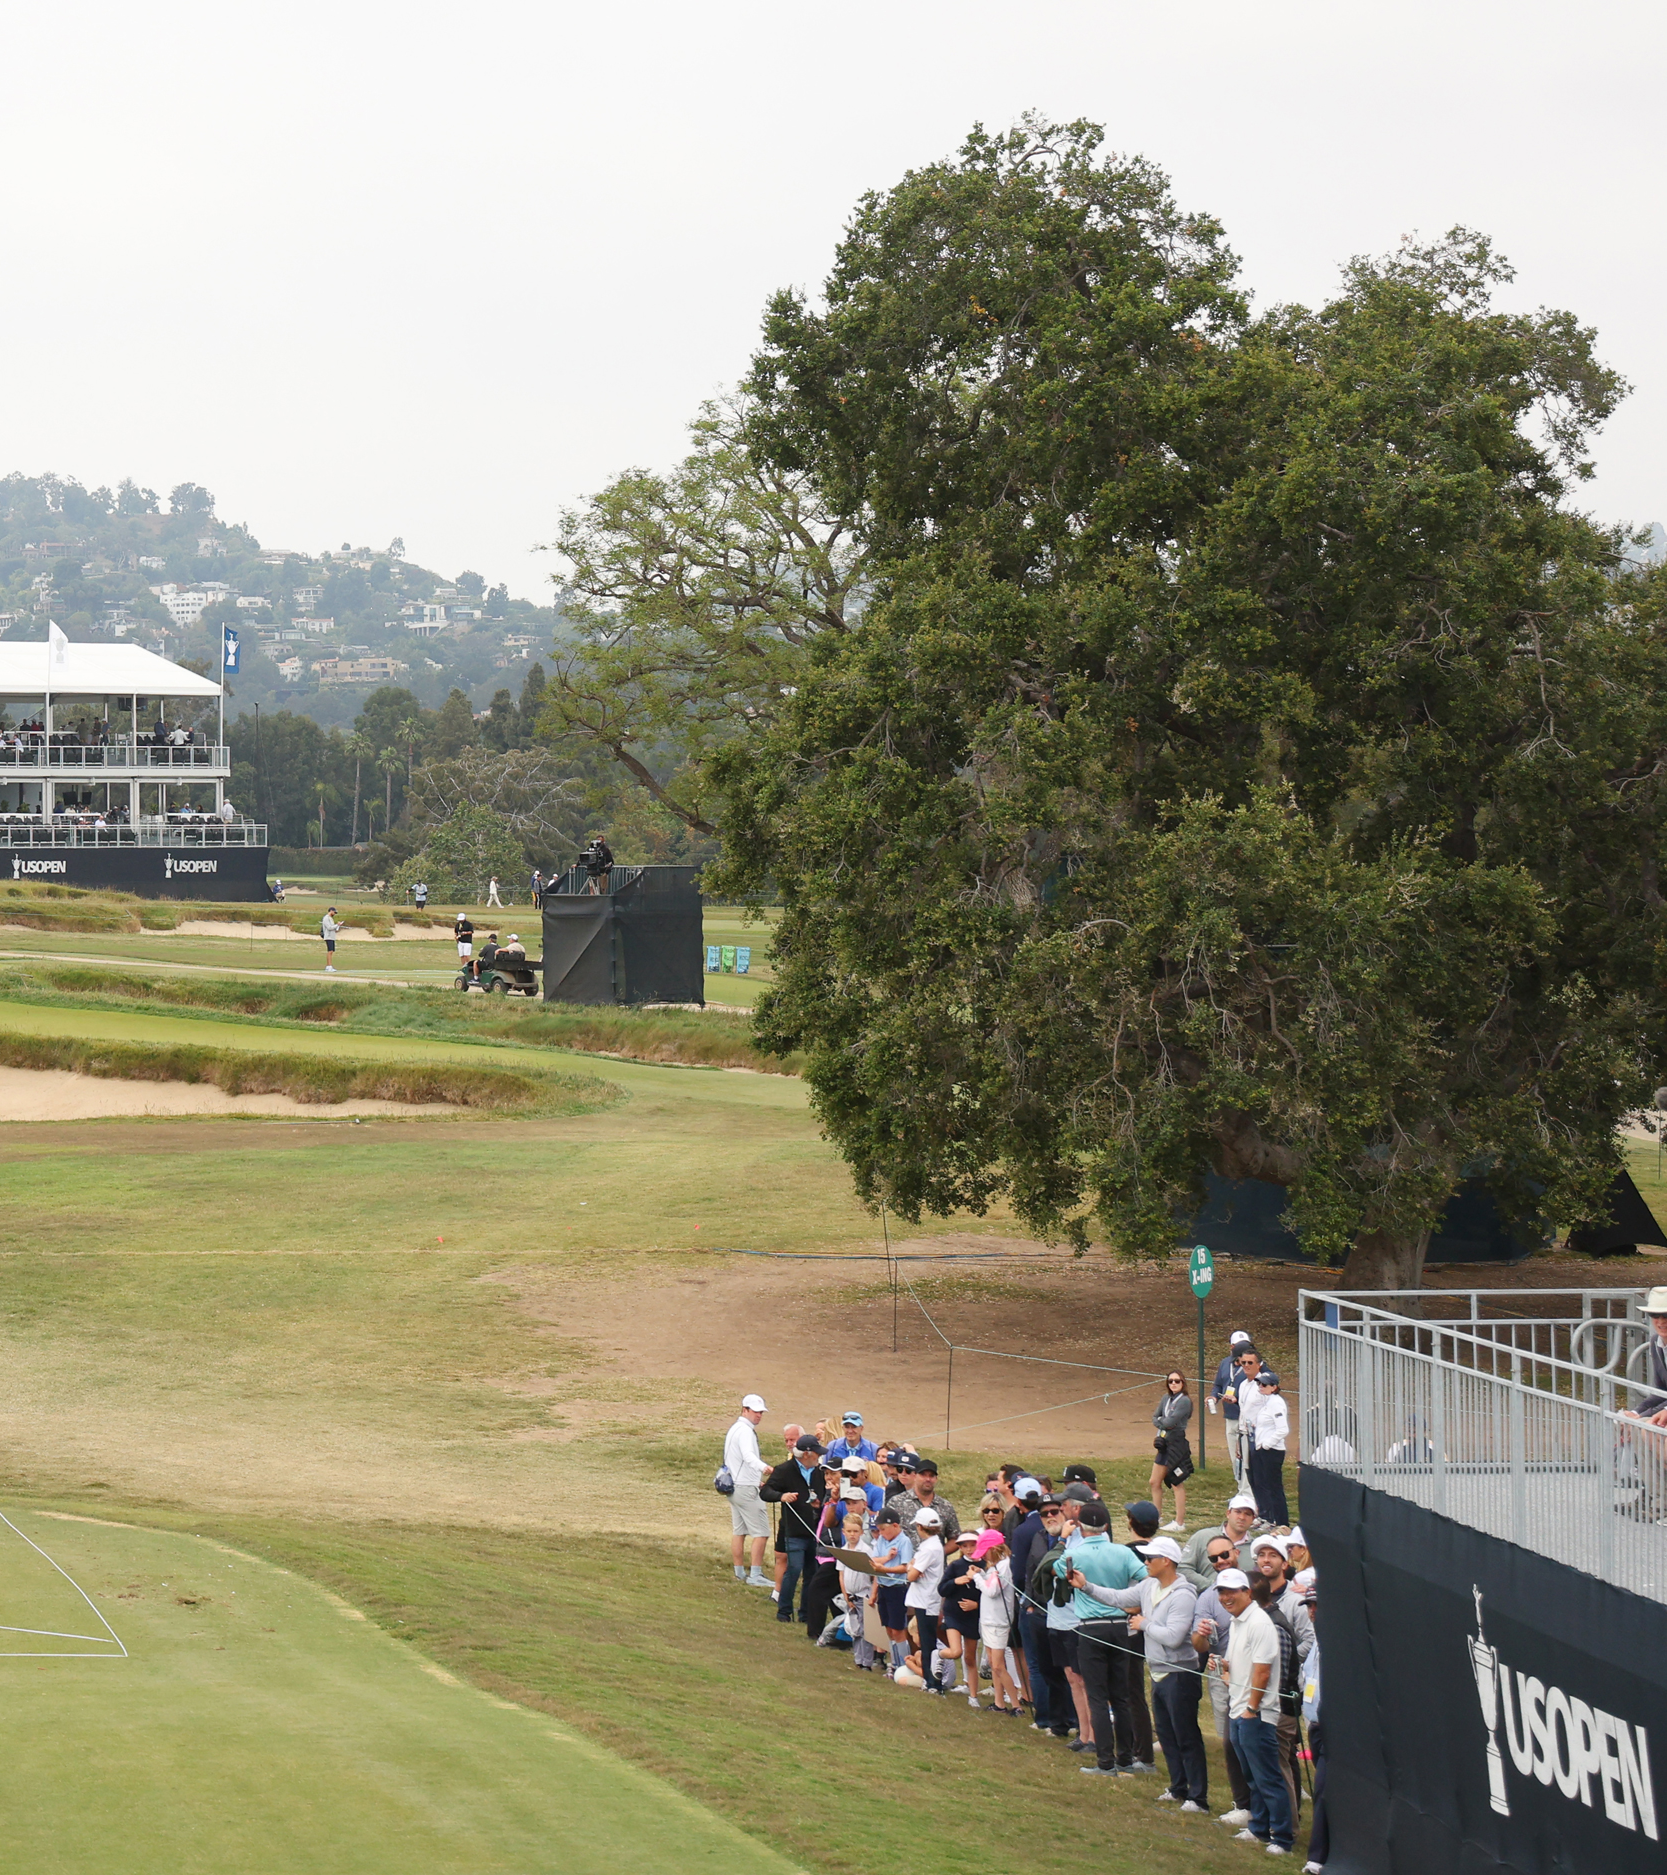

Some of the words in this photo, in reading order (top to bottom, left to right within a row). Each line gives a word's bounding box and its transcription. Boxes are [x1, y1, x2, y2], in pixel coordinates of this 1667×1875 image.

[21, 860, 67, 874] USOPEN
[173, 860, 217, 873] USOPEN
[1197, 1248, 1206, 1264] 15
[1192, 1266, 1212, 1285] X-ING
[1499, 1662, 1659, 1841] USOPEN
